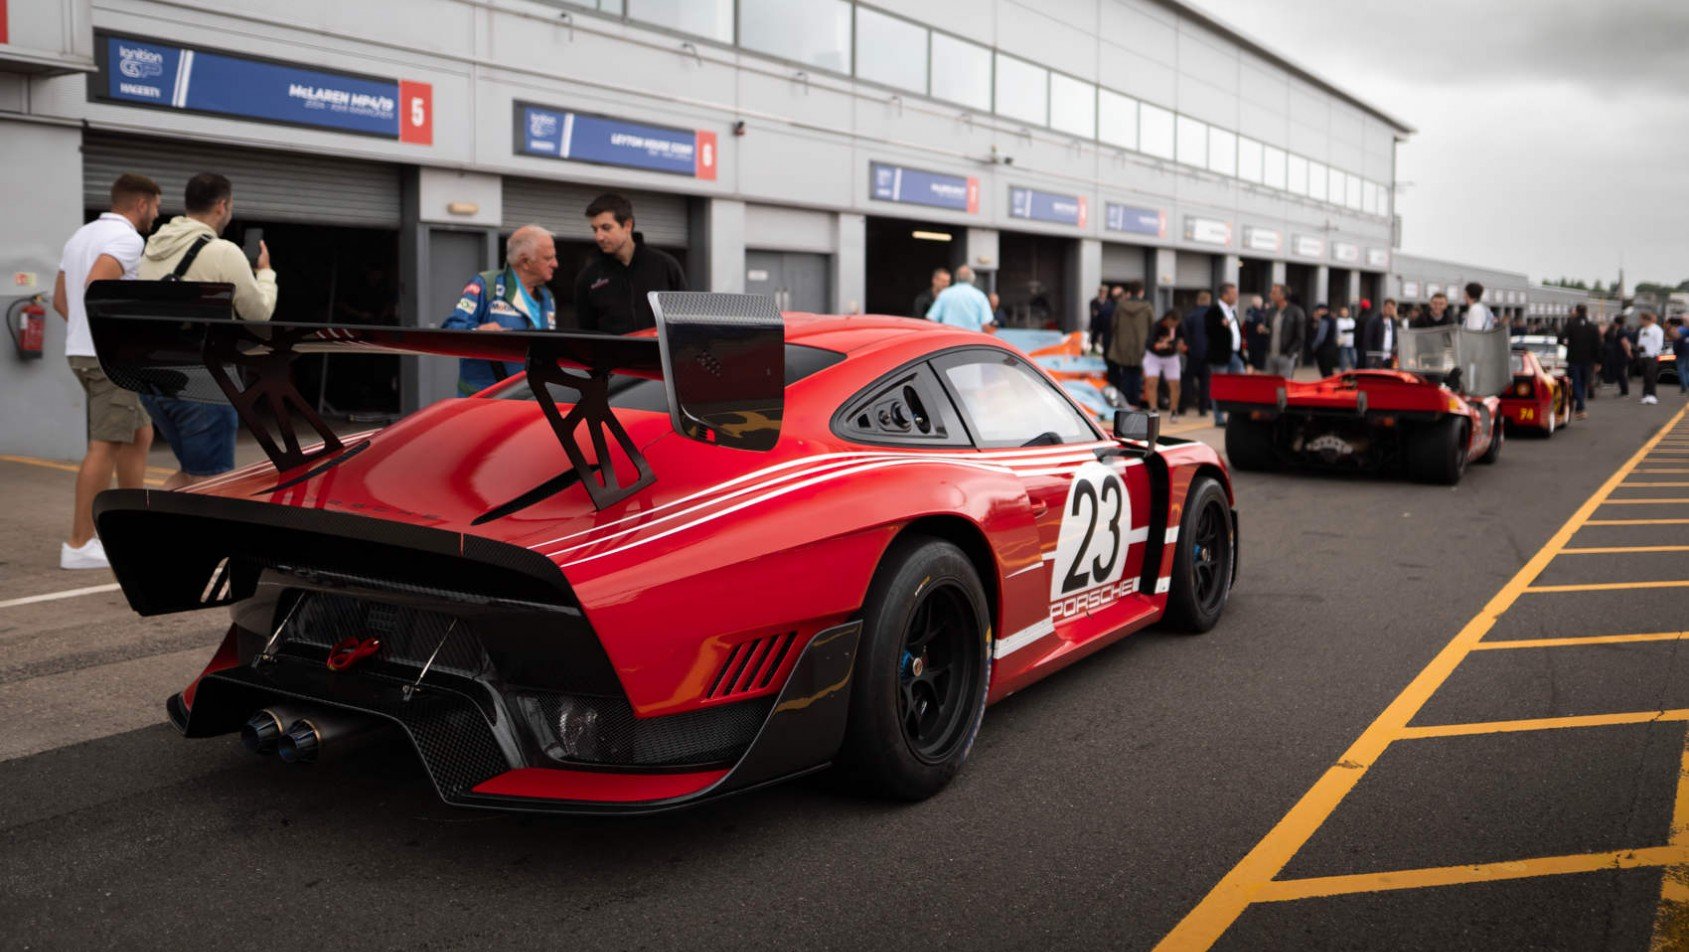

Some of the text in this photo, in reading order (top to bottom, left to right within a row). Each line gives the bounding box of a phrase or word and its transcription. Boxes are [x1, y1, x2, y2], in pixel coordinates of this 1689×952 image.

[289, 84, 350, 105] McLAREN
[411, 97, 424, 127] 5
[1061, 474, 1122, 594] 23
[1049, 578, 1134, 623] PORSCHE
